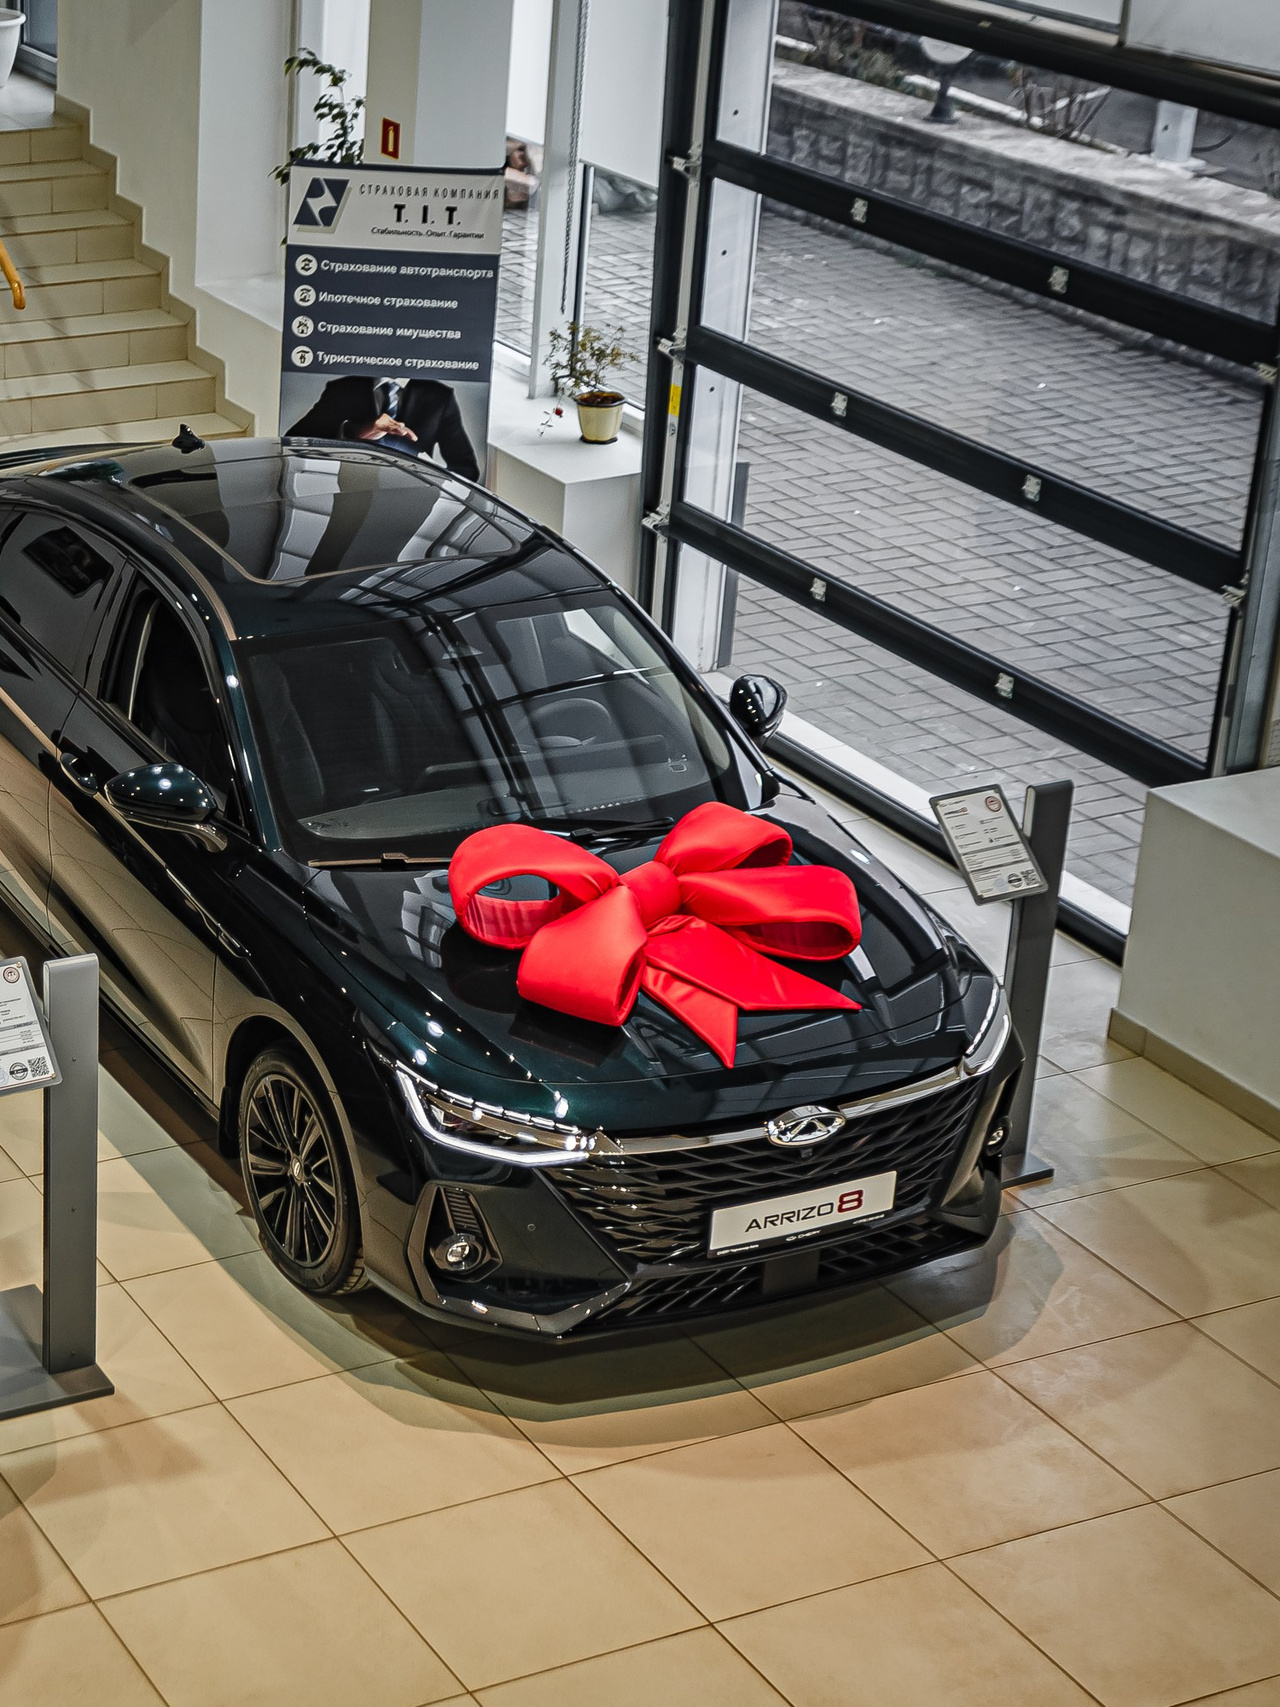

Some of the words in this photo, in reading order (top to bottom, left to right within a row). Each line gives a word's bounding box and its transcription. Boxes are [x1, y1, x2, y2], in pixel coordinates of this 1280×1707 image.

[359, 184, 428, 197] СТРАХОВАЯ
[434, 188, 499, 199] КОМПАНИЯ
[449, 230, 484, 240] Гарантии
[321, 259, 397, 274] Страхование
[399, 266, 494, 280] автотранспорта
[318, 291, 381, 306] Ипотечное
[383, 297, 458, 309] страхование
[318, 321, 393, 335] Страхование
[396, 328, 462, 340] имущества
[316, 351, 403, 367] Туристическое
[404, 358, 480, 370] страхование
[744, 1202, 834, 1233] ARRIZO
[837, 1189, 864, 1213] 8
